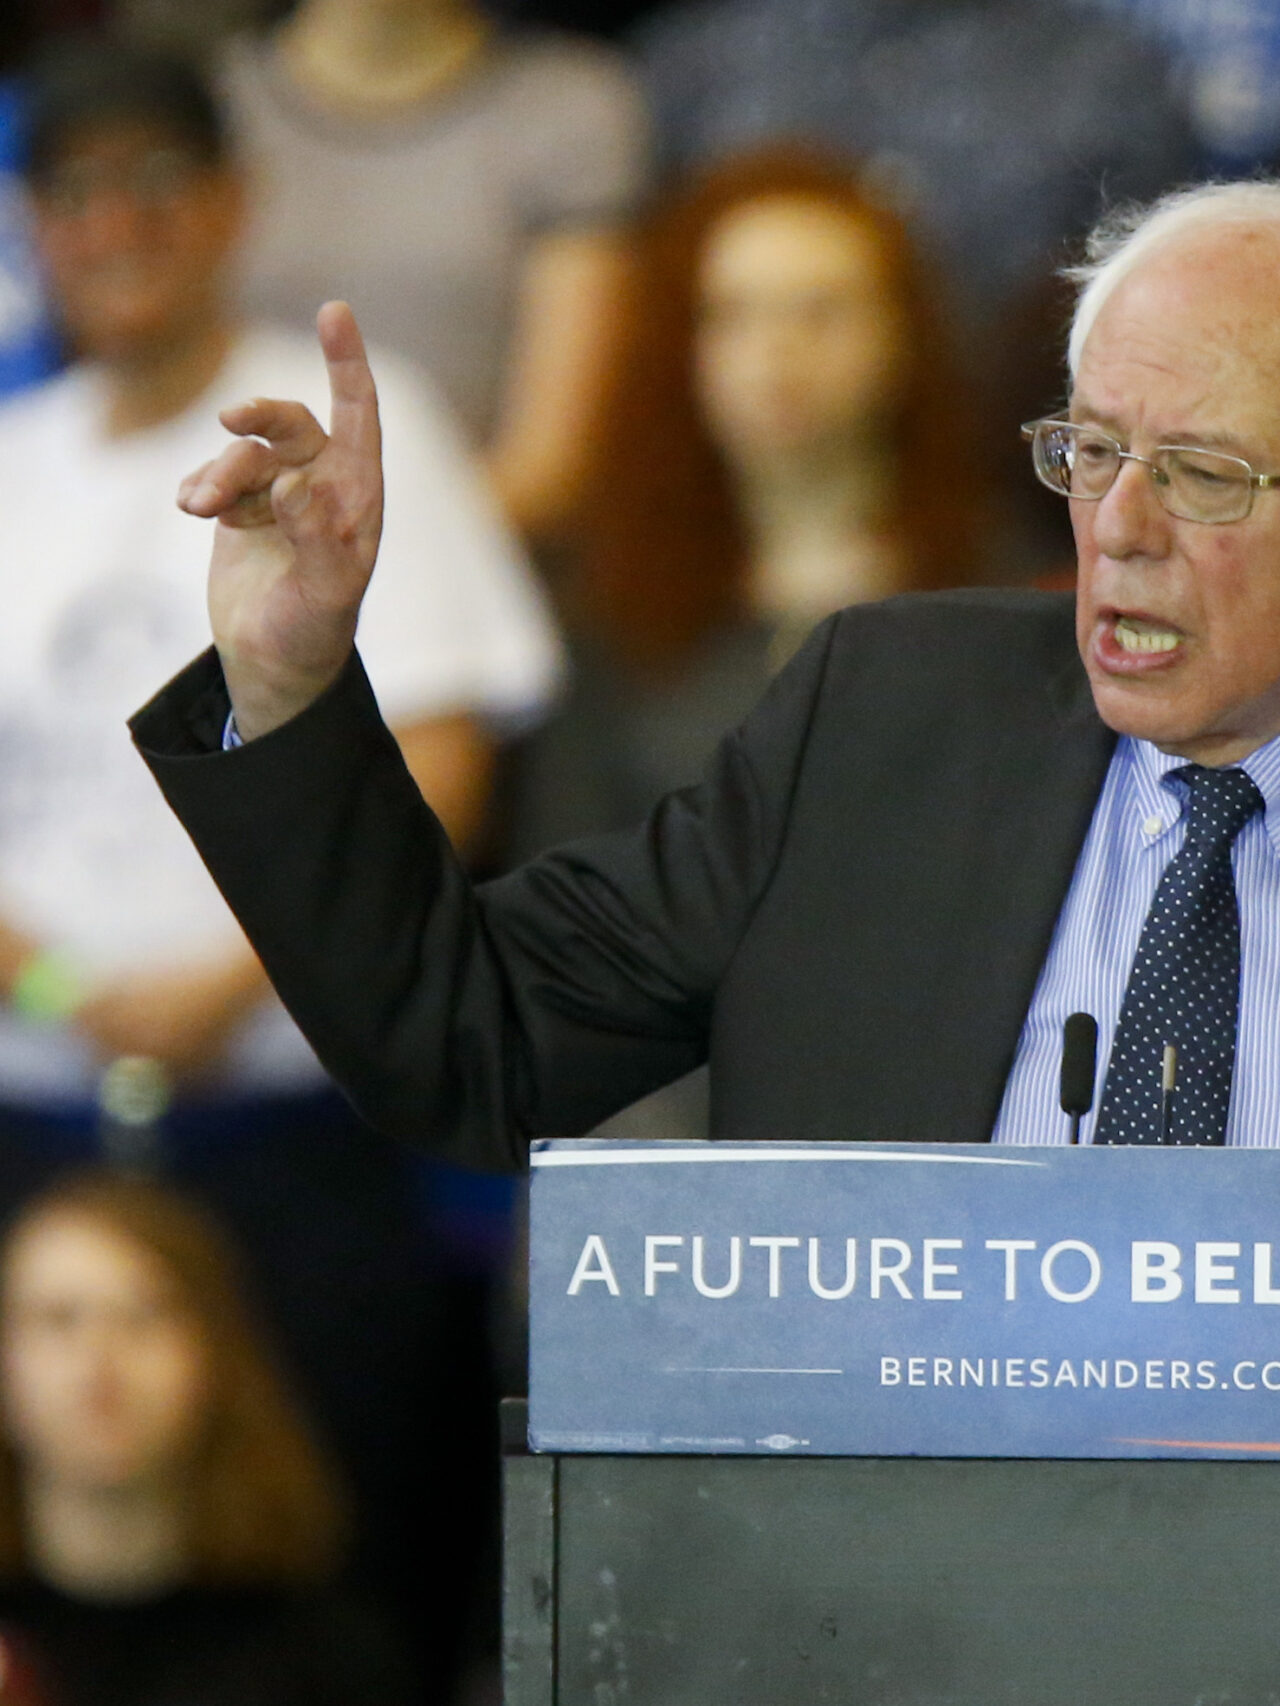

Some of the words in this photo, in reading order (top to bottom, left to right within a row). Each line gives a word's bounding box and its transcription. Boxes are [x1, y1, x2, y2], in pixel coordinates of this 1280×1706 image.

[566, 1235, 621, 1296] A
[643, 1235, 964, 1301] FUTURE
[985, 1239, 1103, 1304] TO
